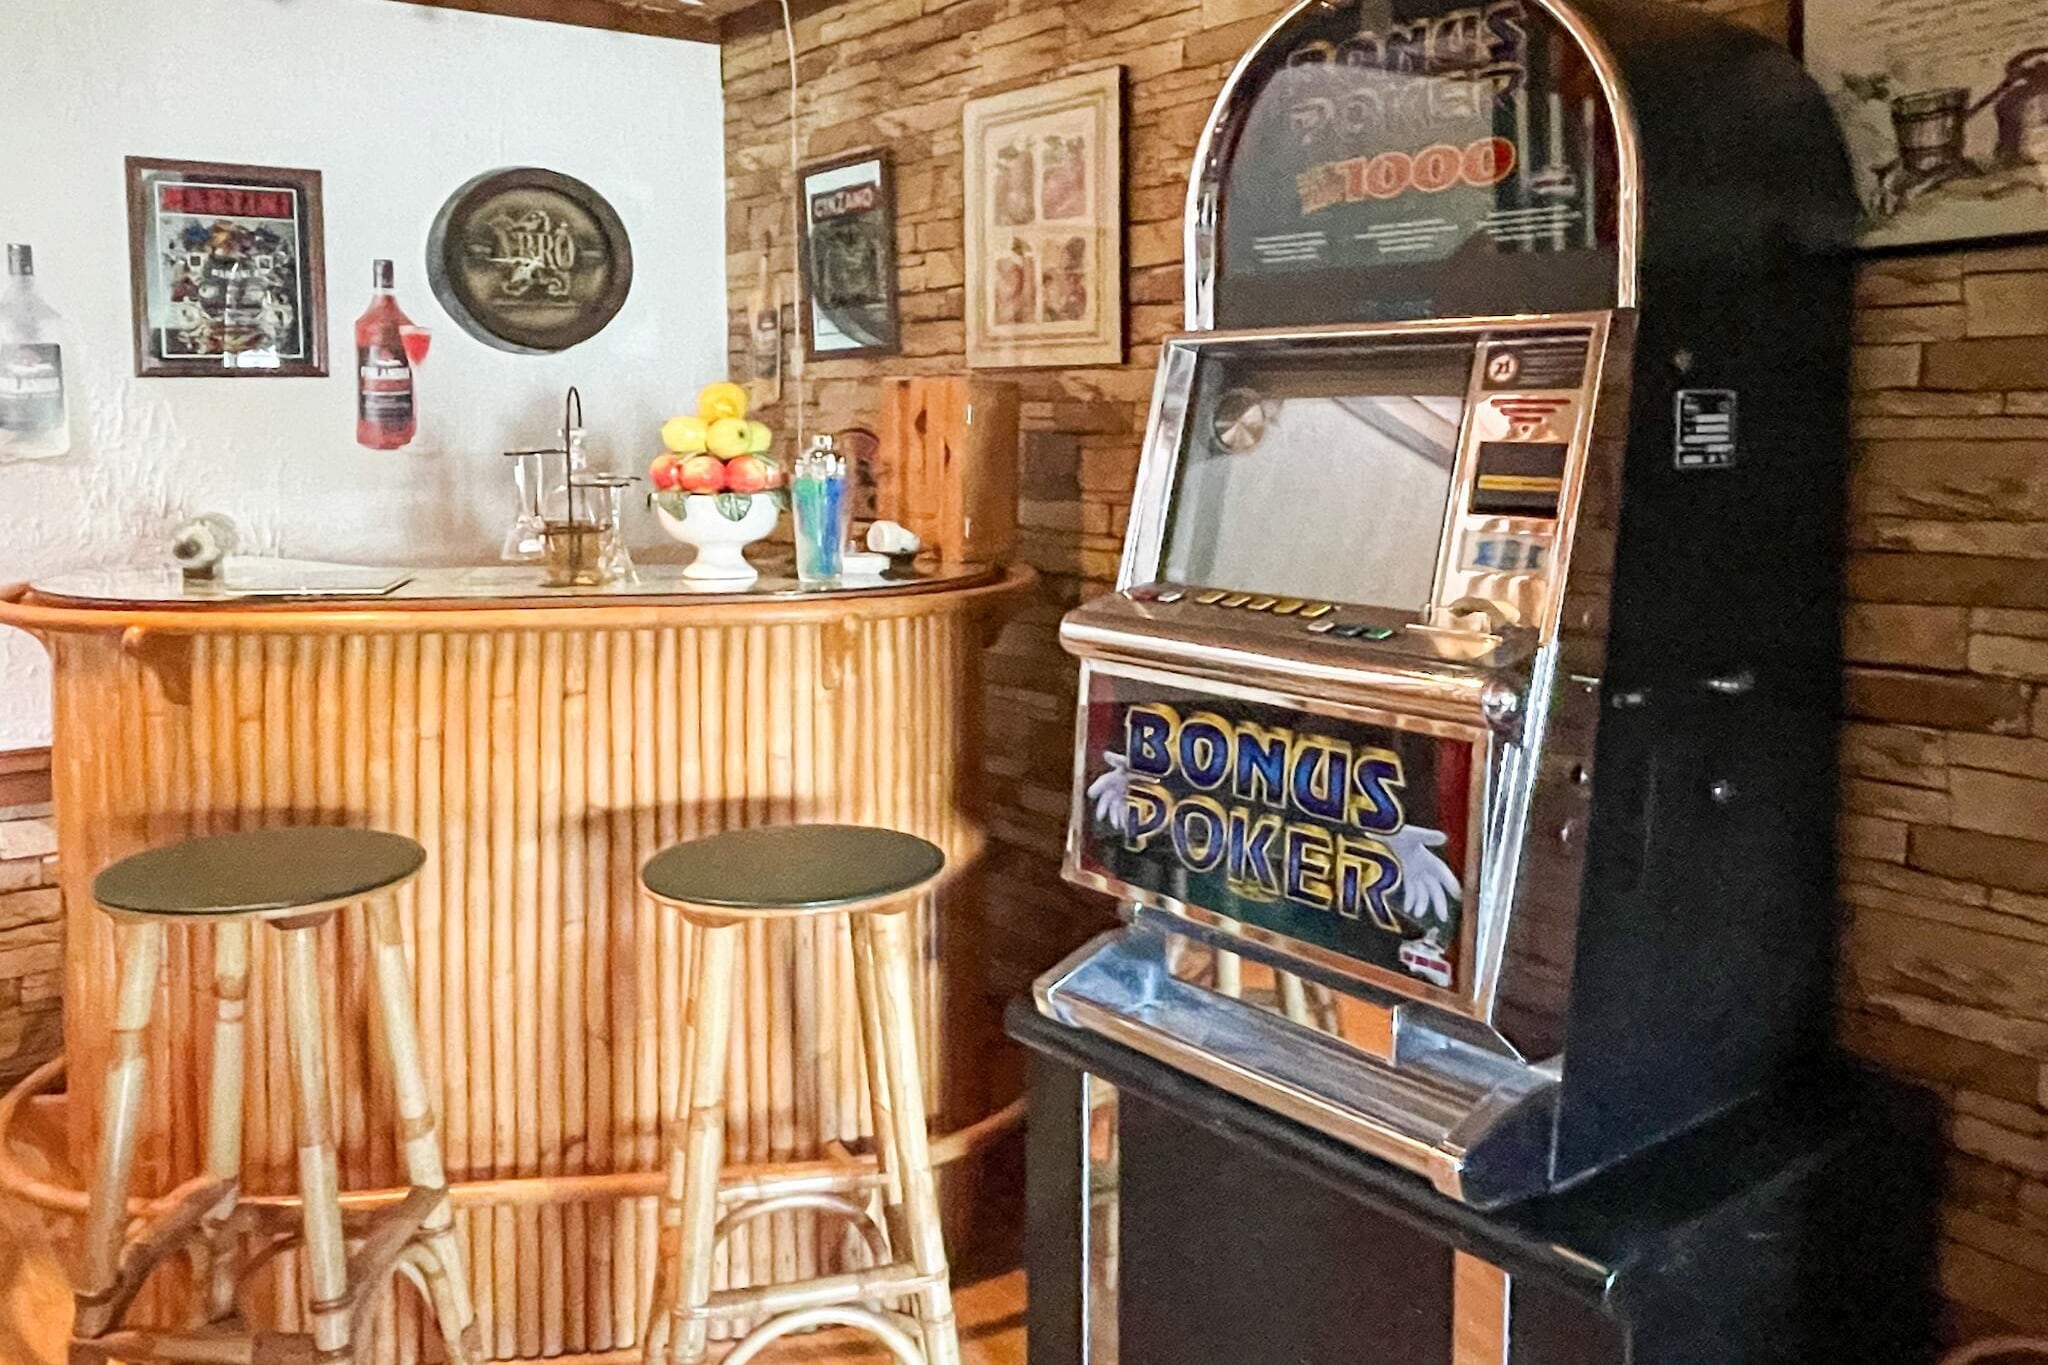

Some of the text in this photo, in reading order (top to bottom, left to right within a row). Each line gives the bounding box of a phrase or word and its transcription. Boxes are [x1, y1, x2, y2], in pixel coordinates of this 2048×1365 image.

[1341, 136, 1516, 203] 1000
[1125, 703, 1406, 835] BONUS
[1124, 782, 1404, 931] POKER
